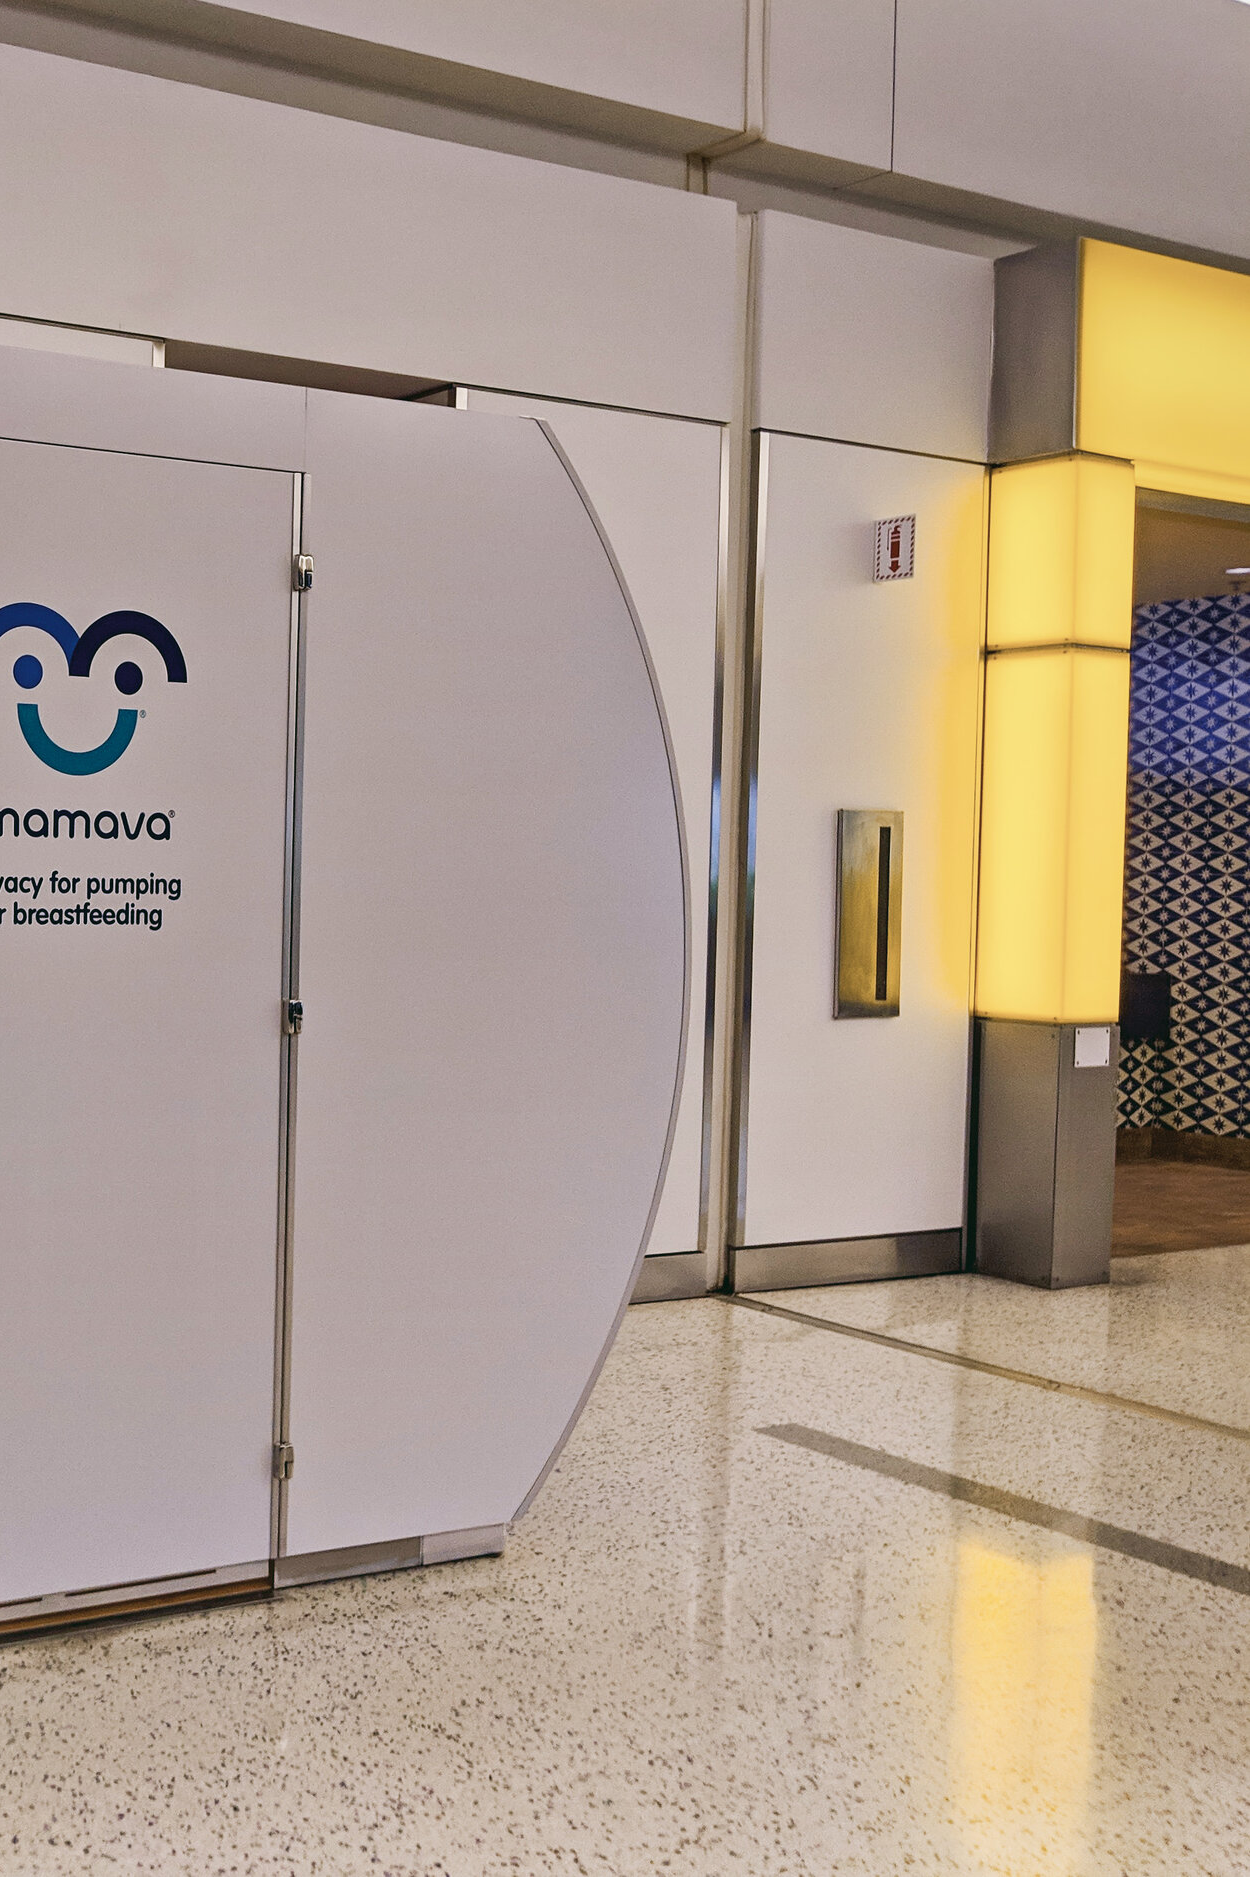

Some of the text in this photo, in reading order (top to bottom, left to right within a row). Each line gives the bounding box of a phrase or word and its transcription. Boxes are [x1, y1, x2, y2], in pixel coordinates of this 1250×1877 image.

[49, 871, 80, 895] for
[86, 873, 182, 901] pumping
[13, 903, 163, 931] breastfeeding
